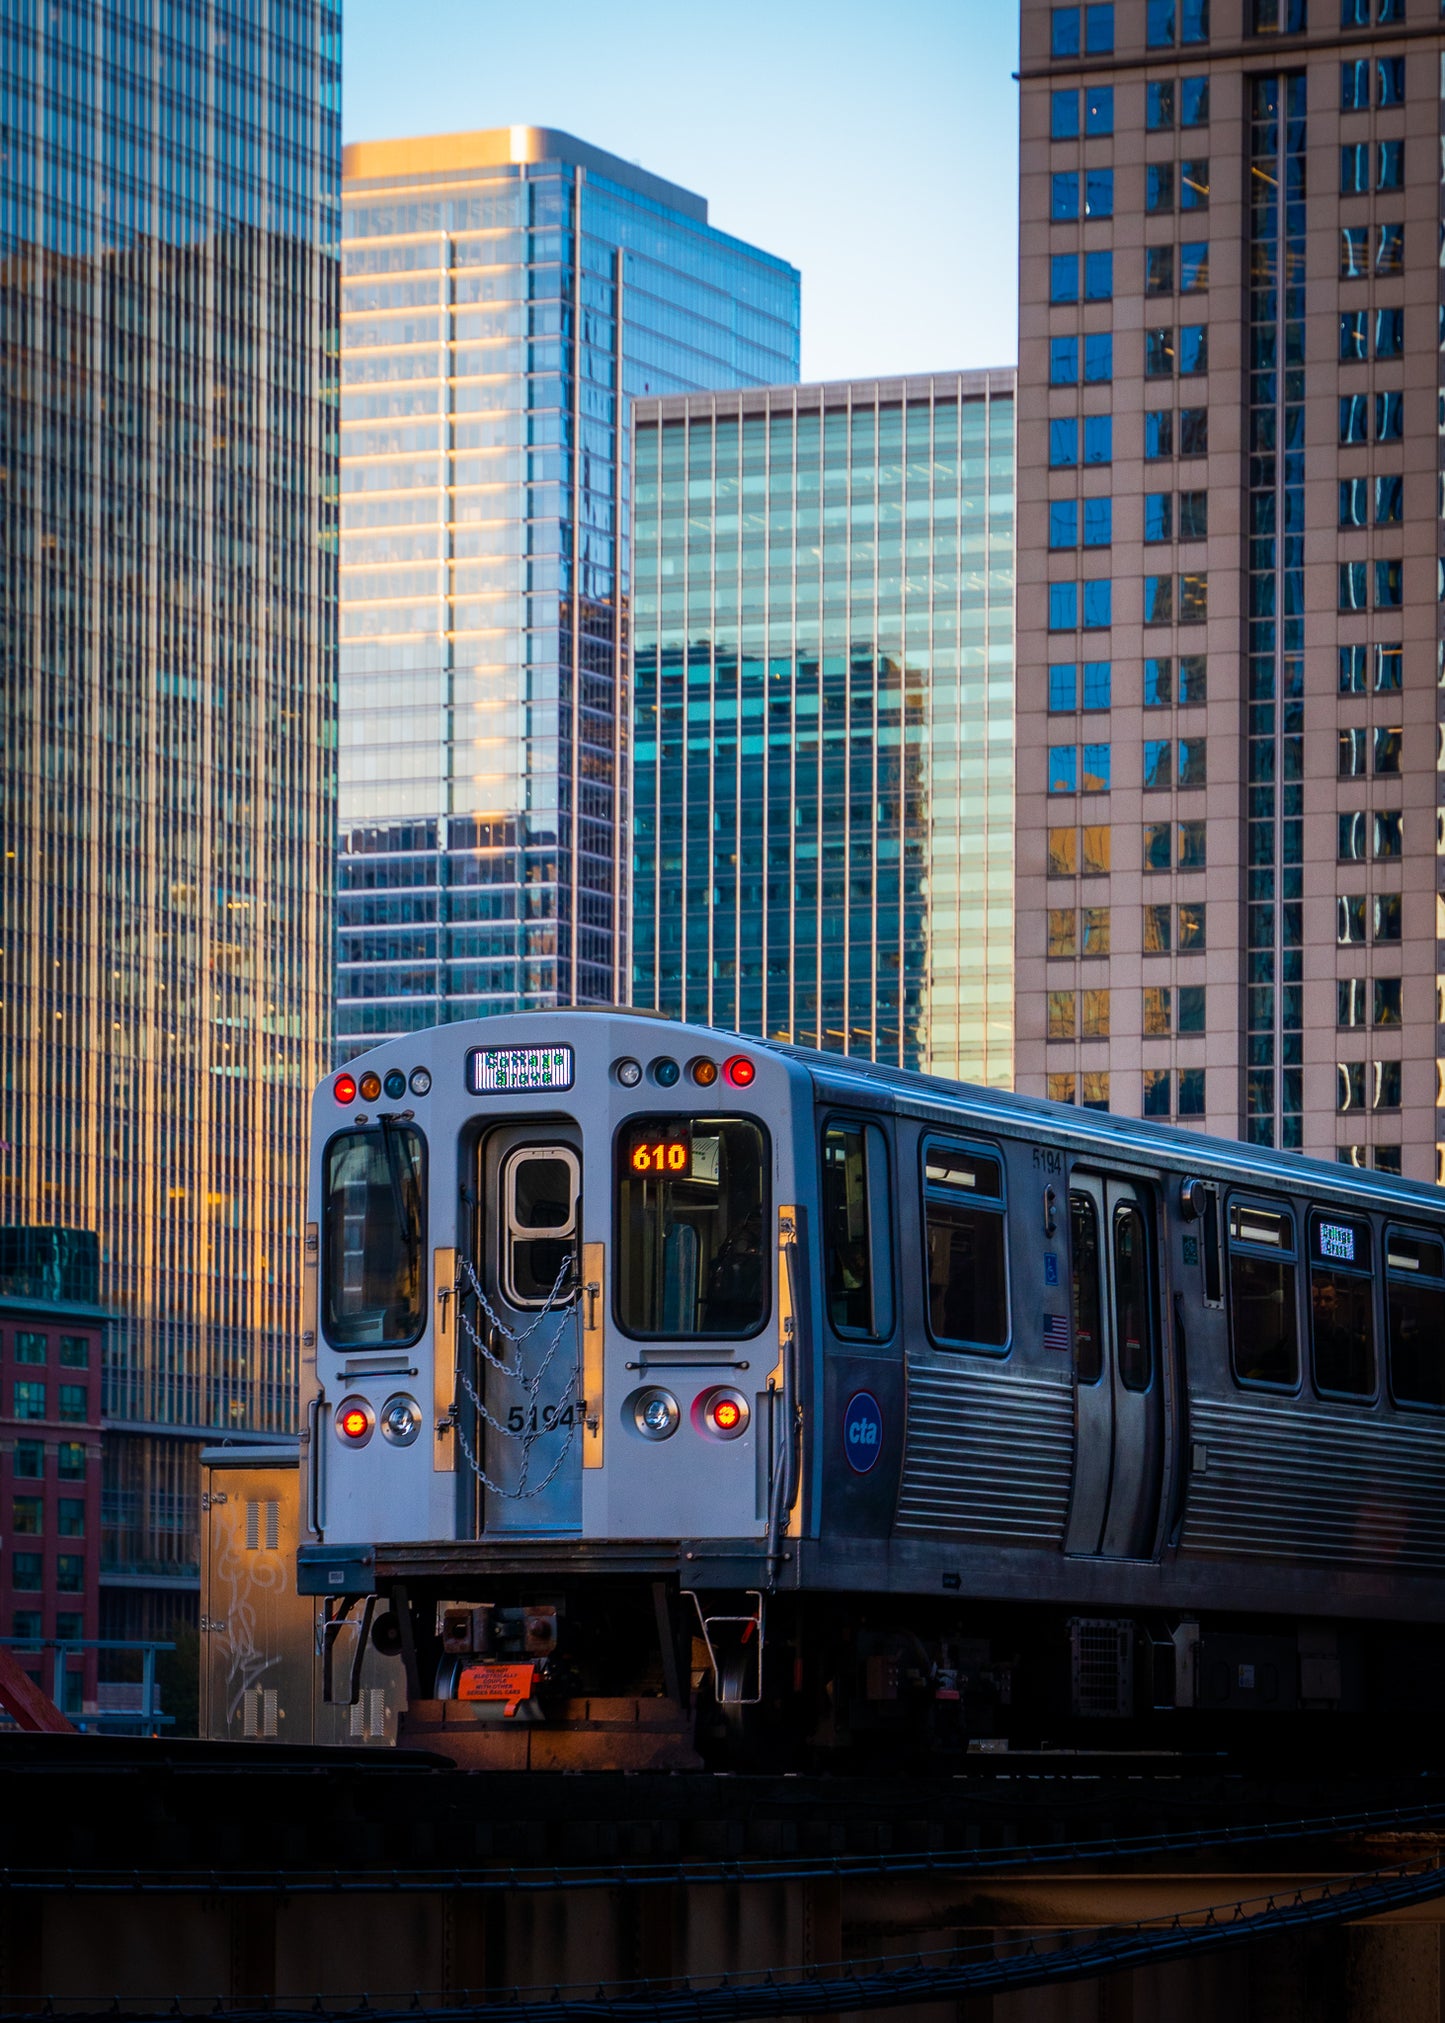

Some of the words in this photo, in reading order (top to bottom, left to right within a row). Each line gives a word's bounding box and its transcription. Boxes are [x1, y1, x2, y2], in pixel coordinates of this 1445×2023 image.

[485, 1053, 564, 1069] Cottage
[496, 1070, 552, 1086] Grove
[633, 1144, 686, 1170] 610
[1032, 1147, 1062, 1175] 5194
[507, 1405, 575, 1432] 5194
[849, 1417, 878, 1445] cta
